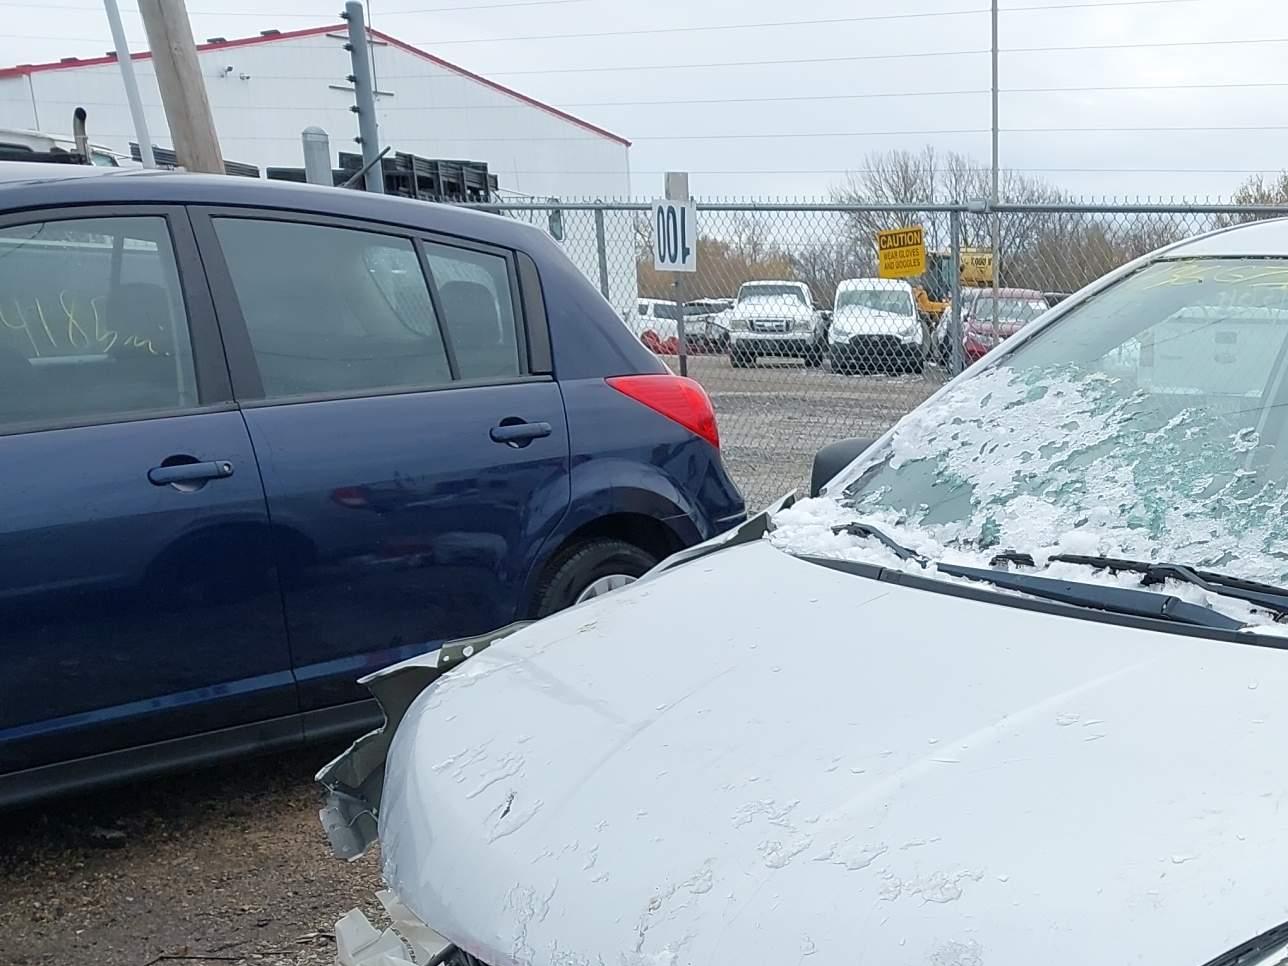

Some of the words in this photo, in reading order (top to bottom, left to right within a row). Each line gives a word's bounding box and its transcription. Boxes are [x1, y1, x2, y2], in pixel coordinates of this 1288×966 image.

[657, 205, 690, 264] 100
[880, 231, 921, 249] CAUTION
[883, 250, 898, 260] WEAR
[898, 248, 920, 258] GLOVES
[884, 261, 895, 271] AND
[895, 258, 921, 269] GOGGLES
